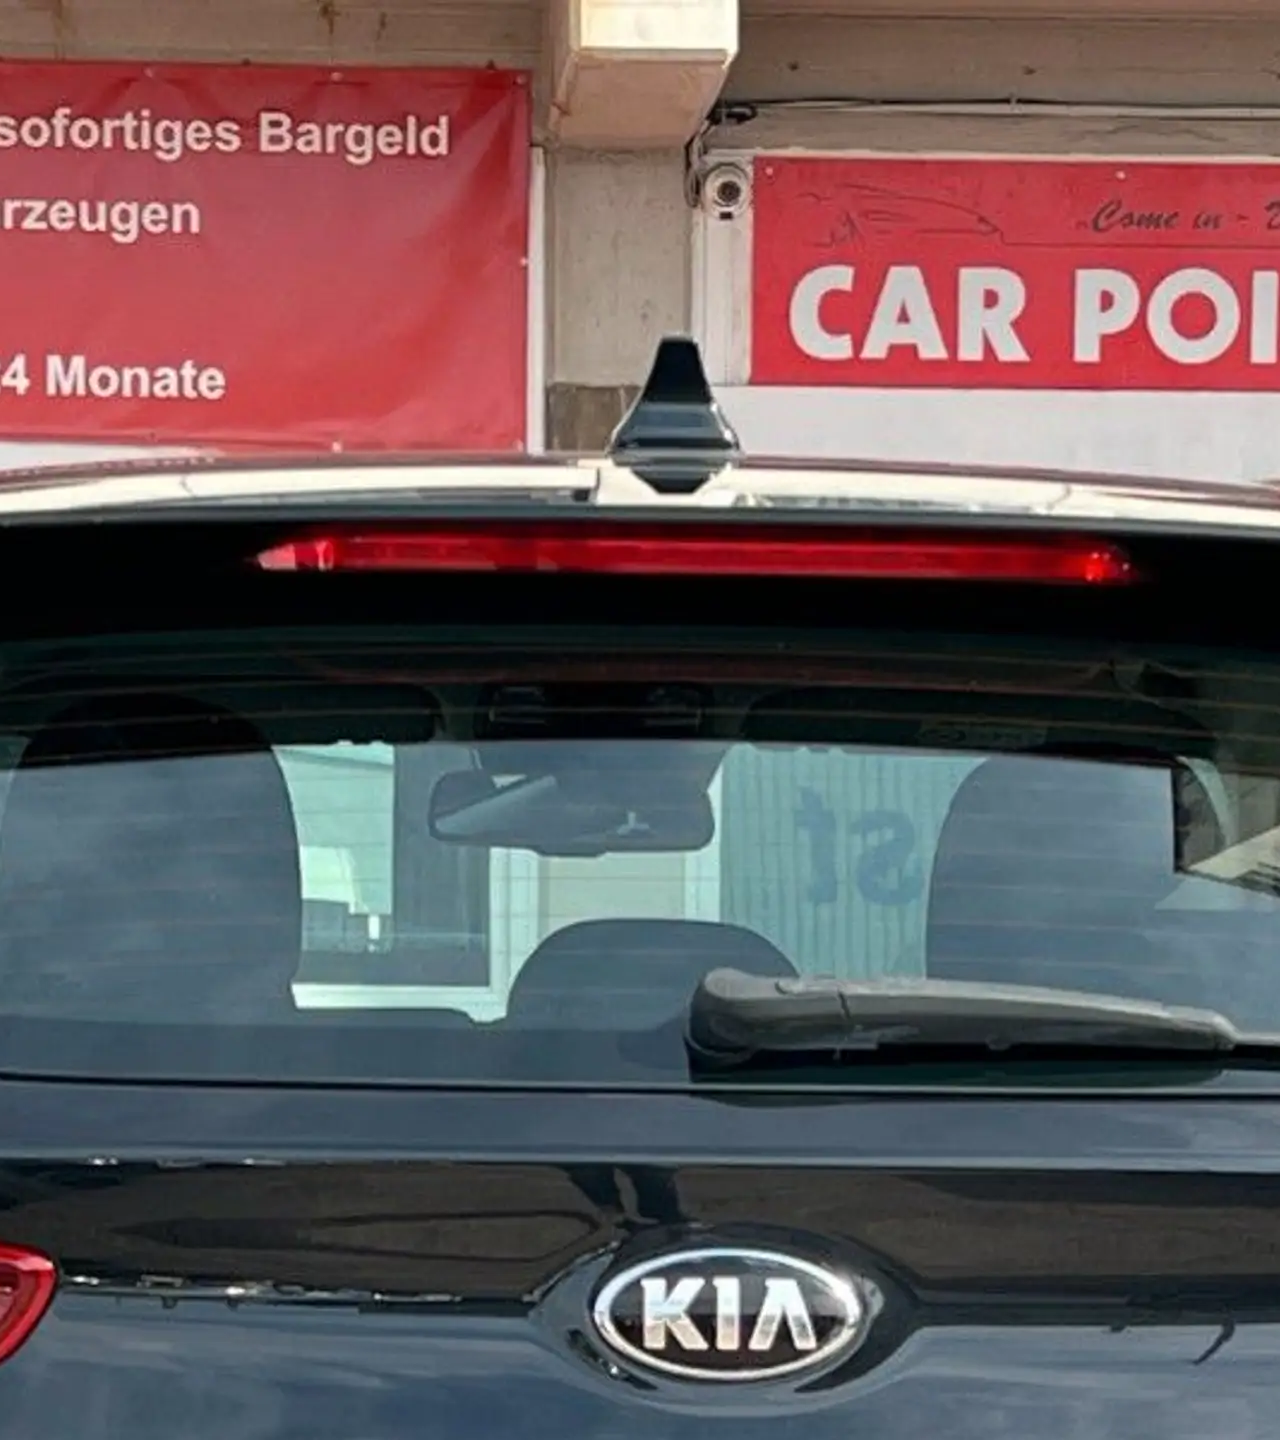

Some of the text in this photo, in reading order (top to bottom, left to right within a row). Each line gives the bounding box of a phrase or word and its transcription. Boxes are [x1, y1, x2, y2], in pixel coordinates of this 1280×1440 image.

[259, 112, 448, 165] Bargeld
[1191, 210, 1224, 231] in
[788, 262, 1031, 362] CAR
[45, 353, 227, 400] Monate
[640, 1276, 818, 1351] KIA
